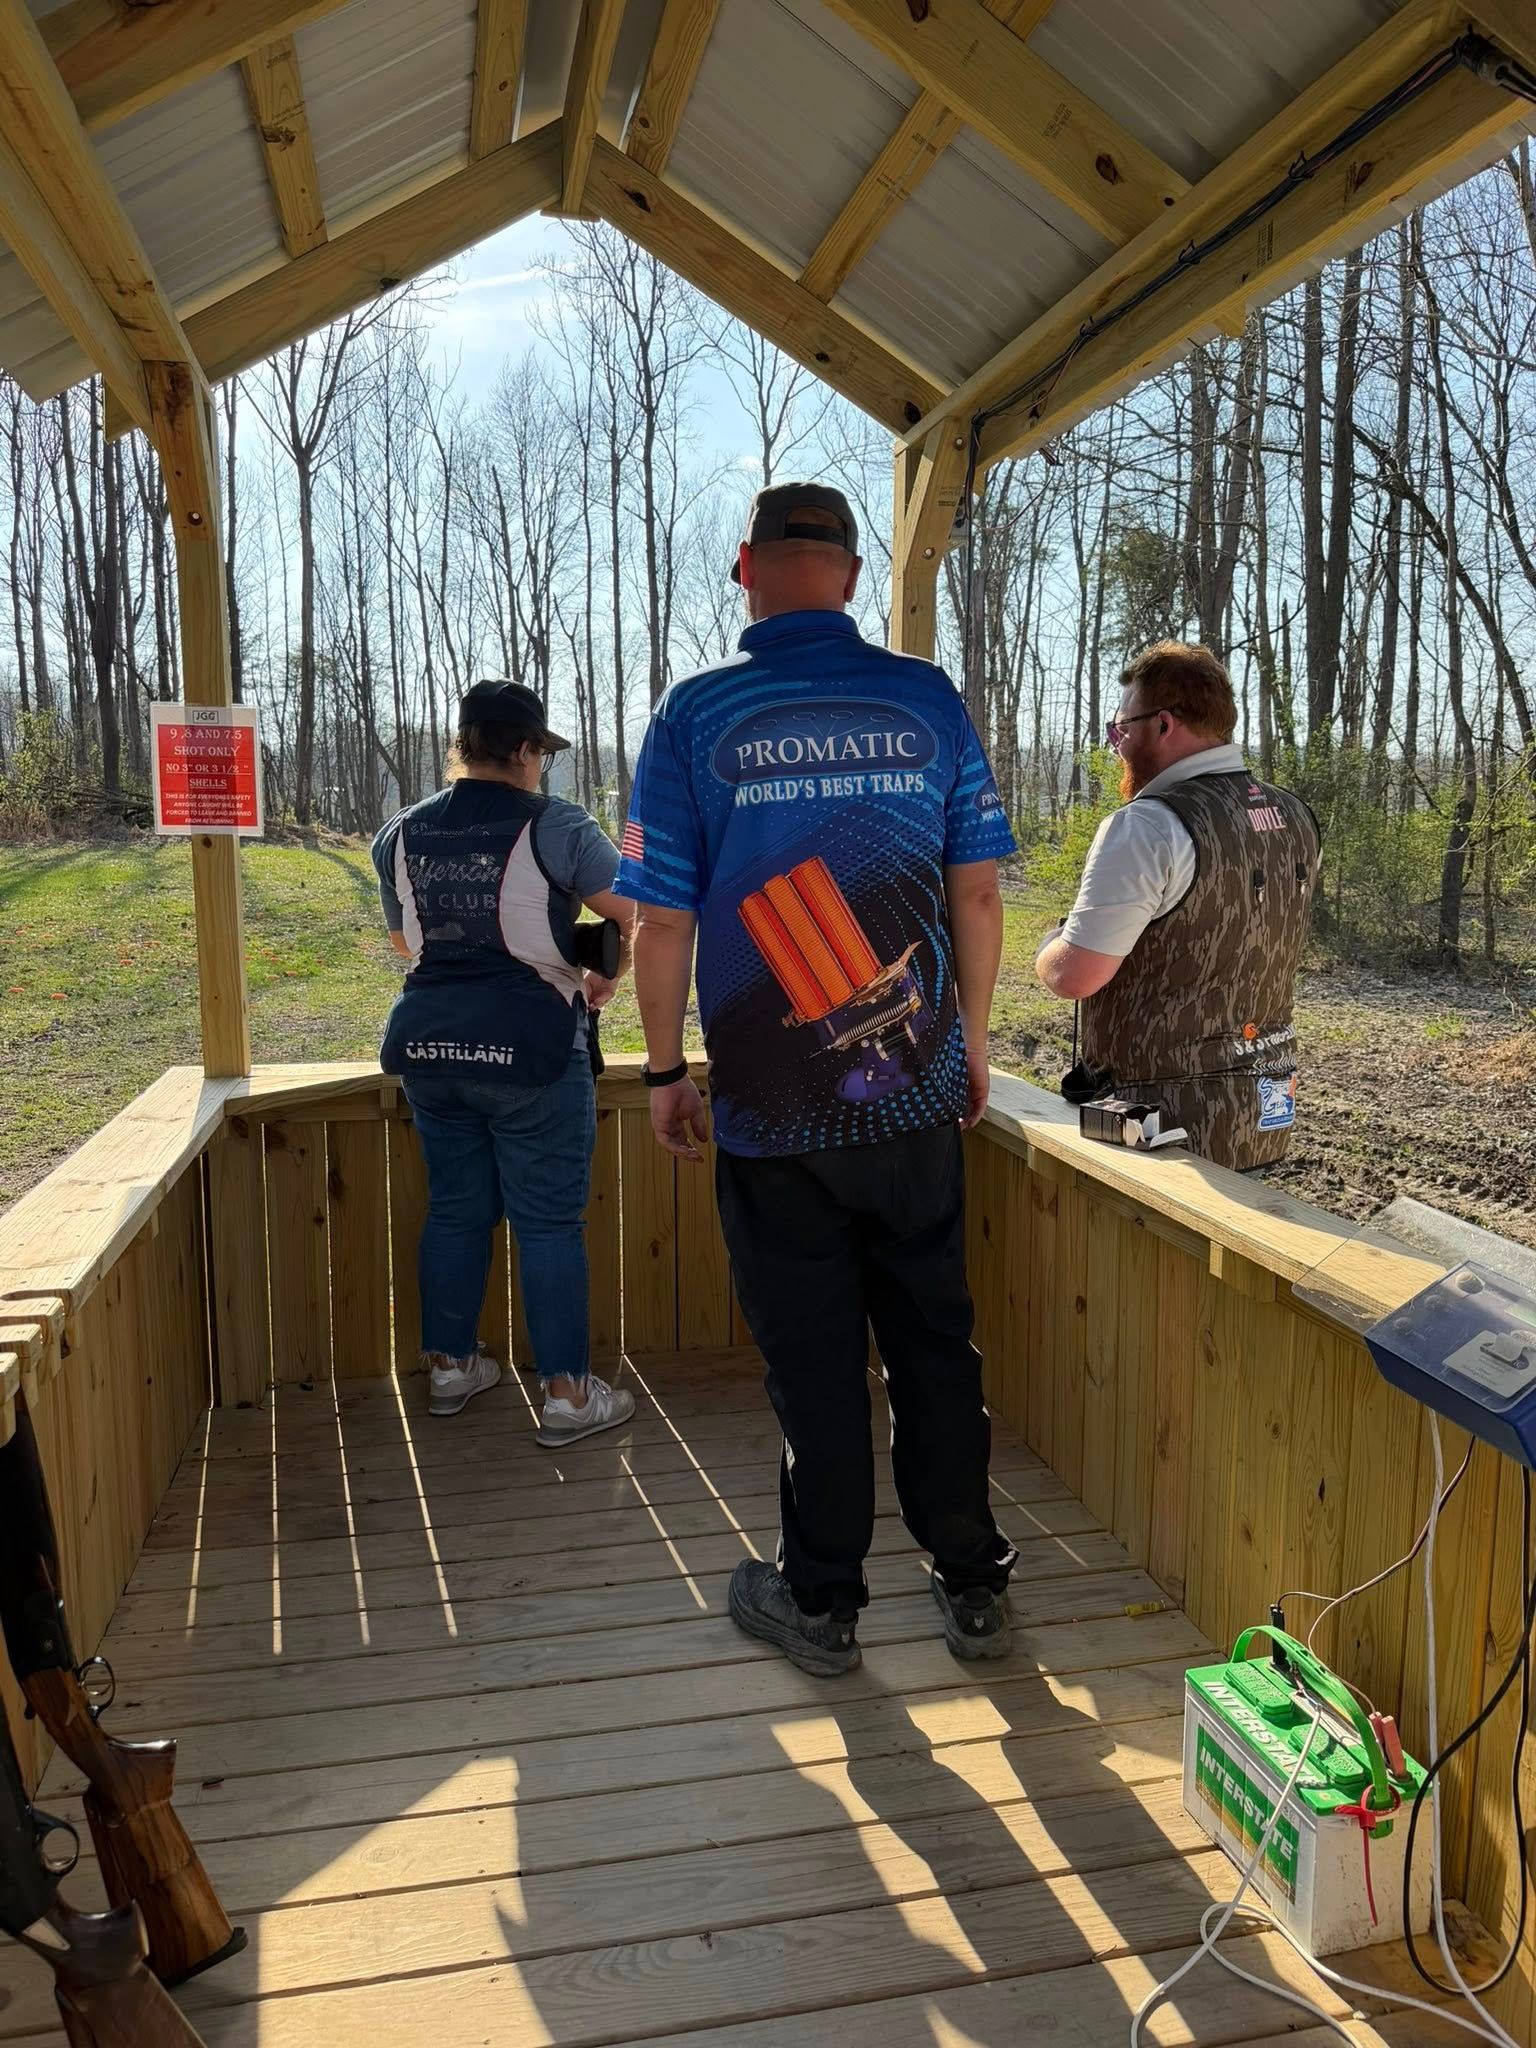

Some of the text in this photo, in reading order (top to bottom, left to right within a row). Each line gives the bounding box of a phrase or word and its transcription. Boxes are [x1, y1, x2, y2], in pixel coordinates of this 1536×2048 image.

[170, 728, 178, 739] 9
[195, 729, 220, 739] AND
[224, 730, 242, 740] 7.5
[174, 745, 240, 756] SHOT ONLY
[735, 732, 918, 770] PROMATIC
[166, 763, 180, 771] NO
[195, 764, 209, 772] OR
[212, 764, 218, 772] 3
[189, 778, 227, 787] SHELLS
[735, 773, 925, 807] WORLD'S BEST TRAPS
[439, 893, 497, 910] CLUB
[405, 1041, 514, 1065] CASTELLANI
